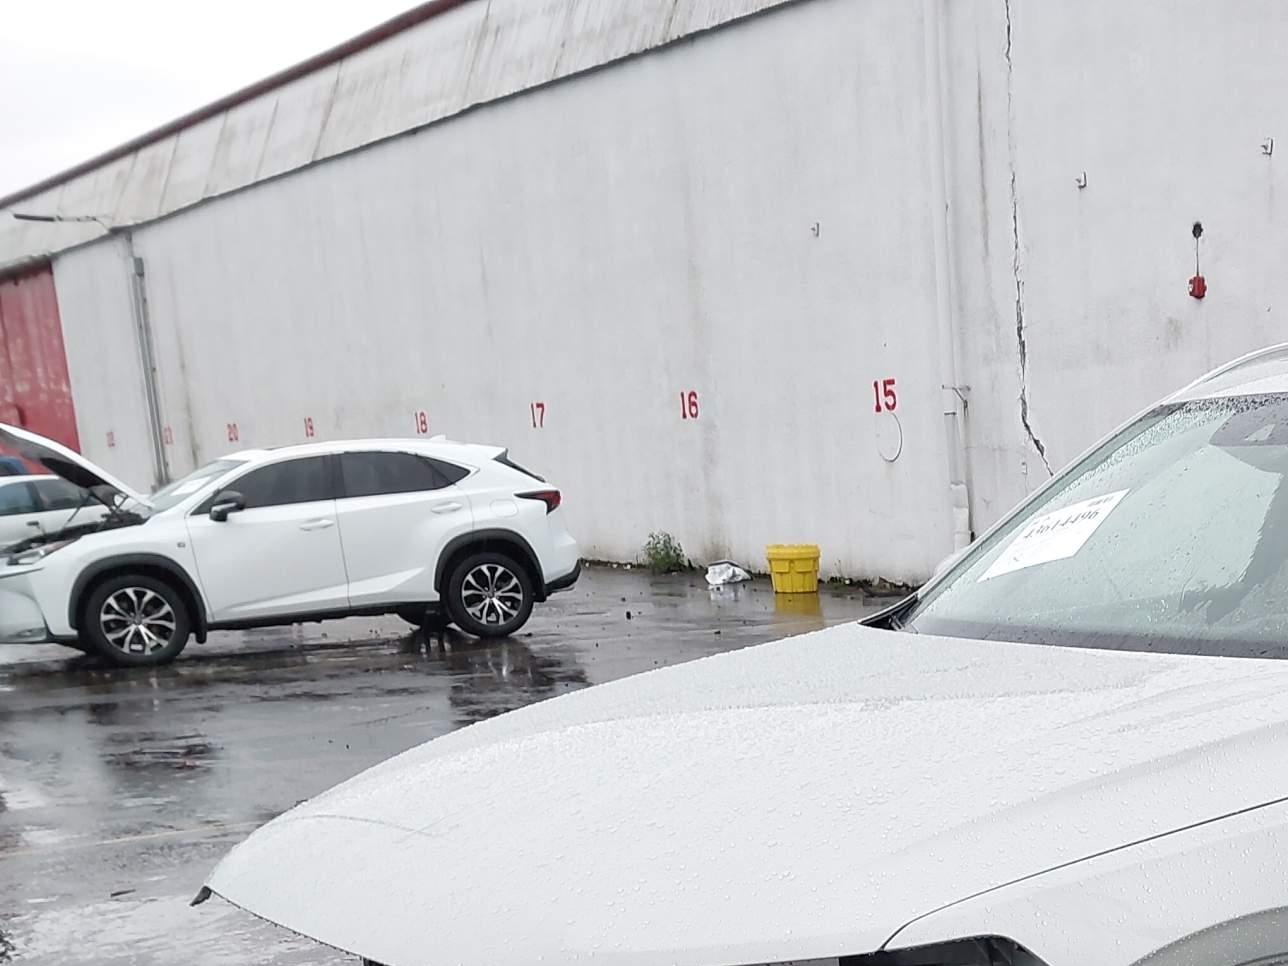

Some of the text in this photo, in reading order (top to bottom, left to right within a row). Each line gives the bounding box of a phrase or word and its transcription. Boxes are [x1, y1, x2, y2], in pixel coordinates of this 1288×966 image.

[680, 391, 699, 419] 16
[873, 378, 897, 413] 15
[303, 417, 315, 438] 19
[414, 411, 429, 434] 18
[529, 402, 545, 429] 17
